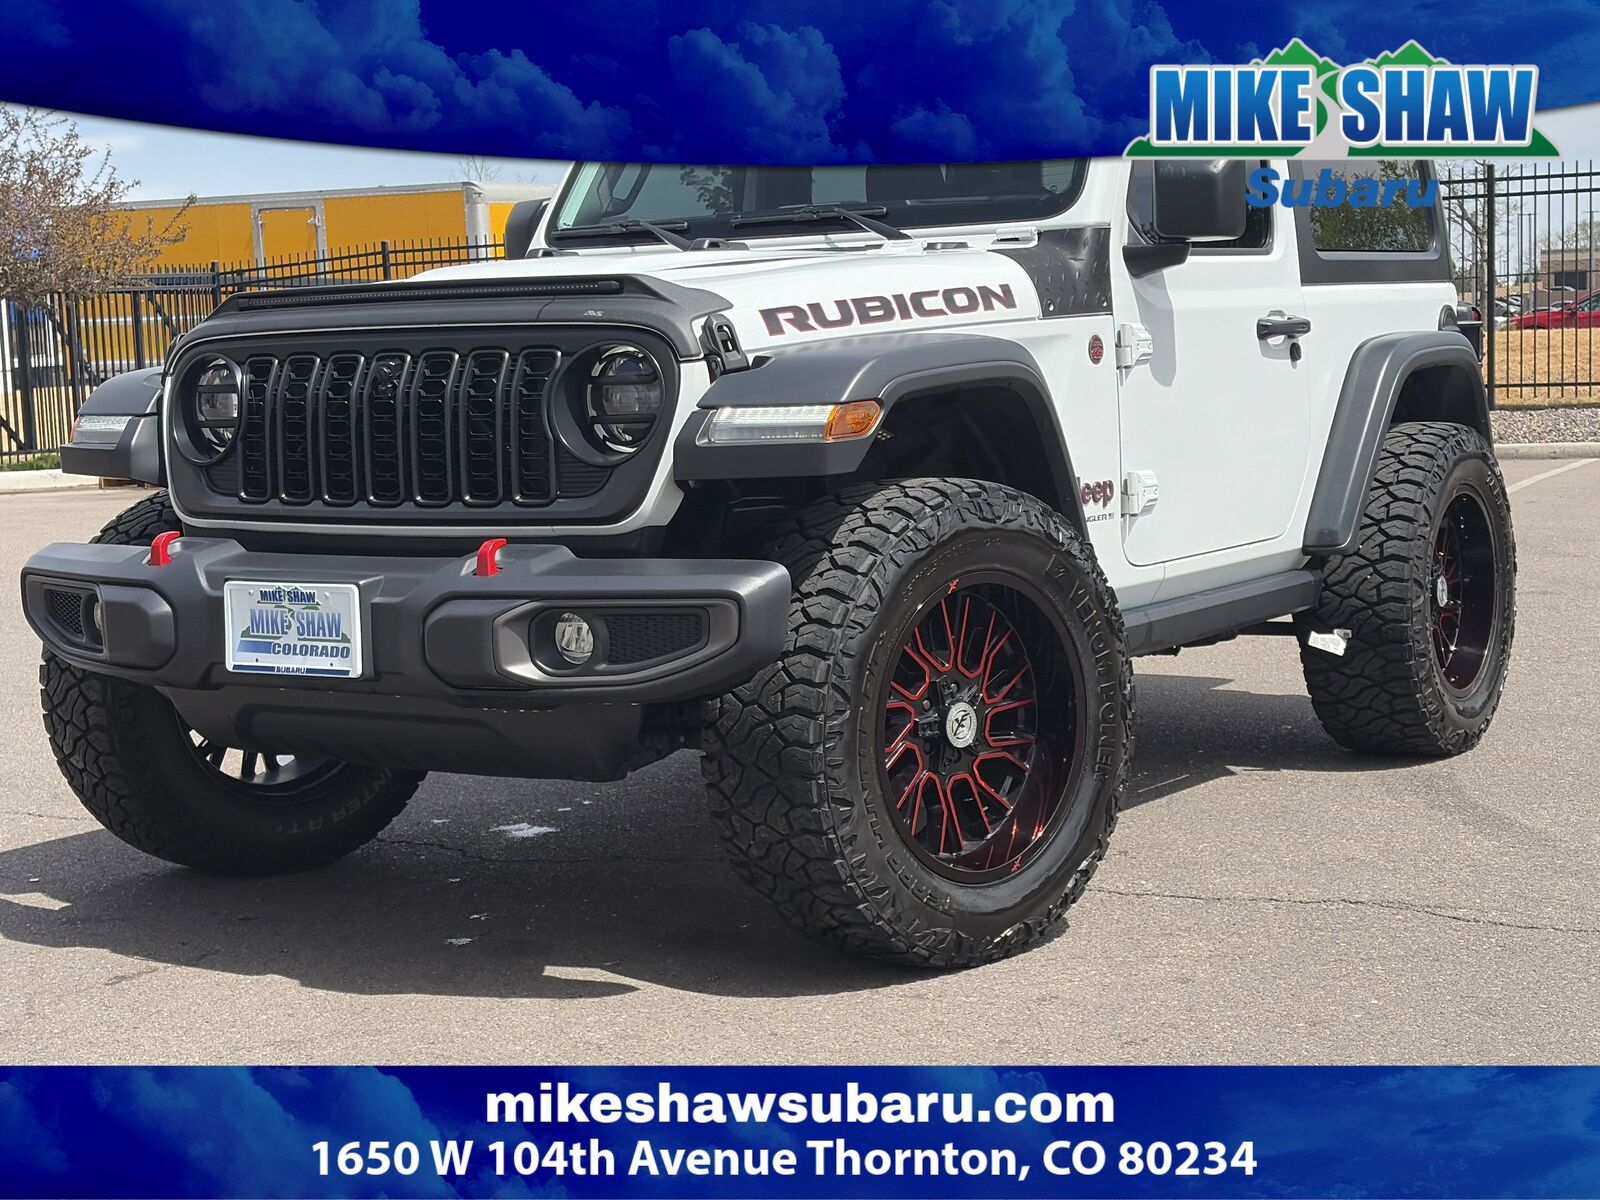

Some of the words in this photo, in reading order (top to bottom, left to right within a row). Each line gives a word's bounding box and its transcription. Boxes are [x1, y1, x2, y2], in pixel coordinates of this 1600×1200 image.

[758, 283, 1017, 337] RUBICON
[260, 589, 284, 602] MIKE
[287, 590, 316, 603] SHAW
[251, 608, 289, 635] MIKE
[296, 612, 342, 638] SHAW
[271, 643, 350, 659] COLORADO
[275, 666, 306, 674] SUBARU
